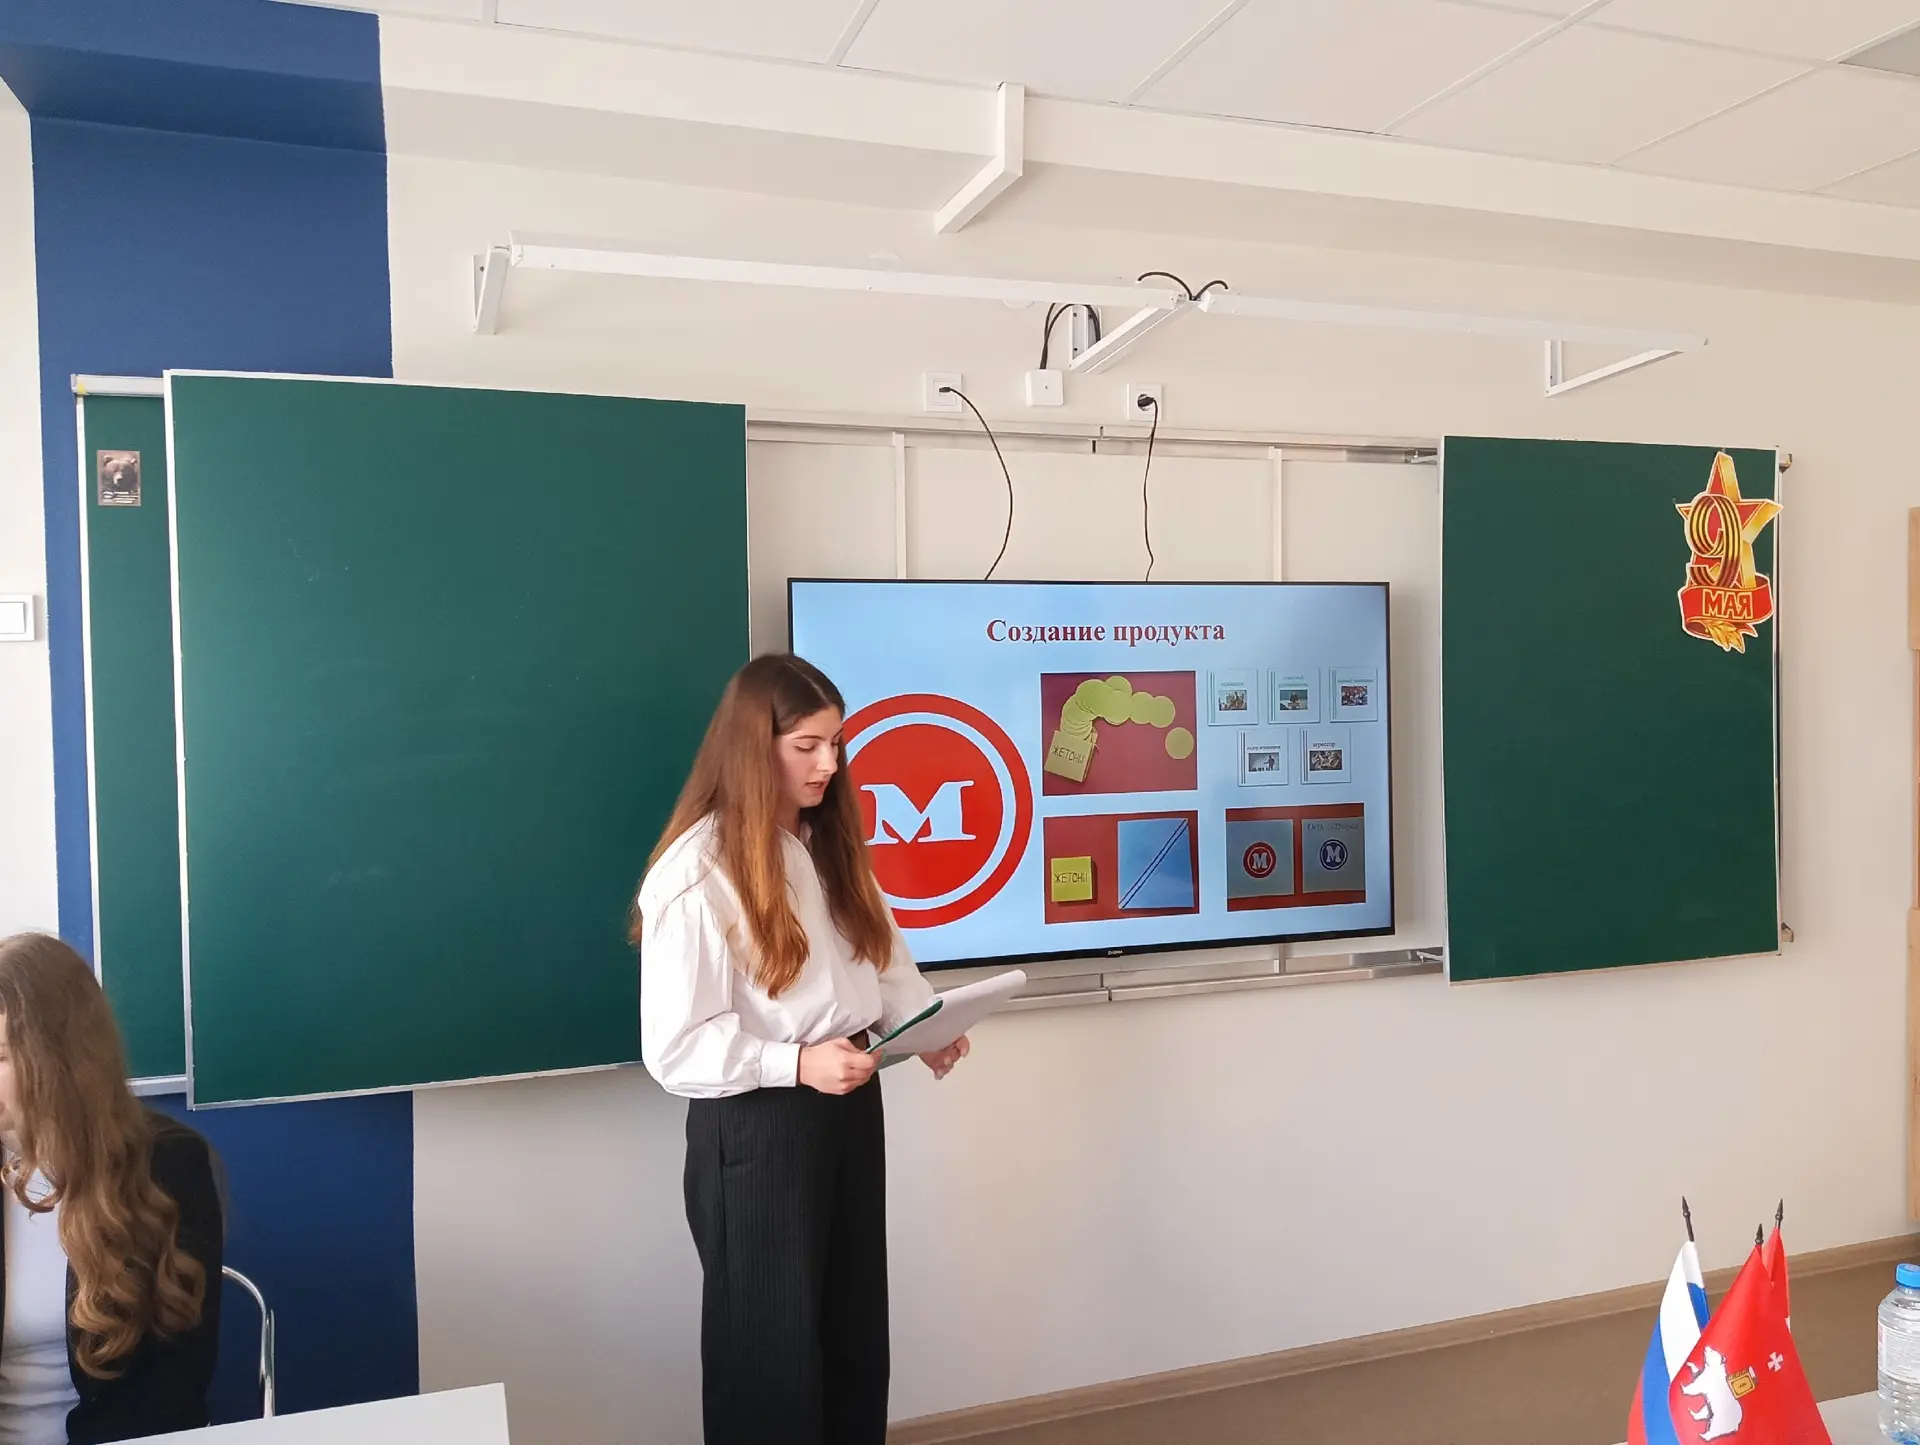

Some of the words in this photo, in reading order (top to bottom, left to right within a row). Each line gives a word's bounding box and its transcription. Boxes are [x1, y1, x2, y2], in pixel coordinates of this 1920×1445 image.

[1688, 493, 1742, 588] 9
[1702, 589, 1754, 619] МАЯ
[986, 619, 1106, 644] Создание
[1113, 624, 1225, 647] продукта
[1052, 745, 1085, 764] ЖЕТОНЫ
[860, 780, 977, 846] М
[1053, 872, 1088, 884] ЖЕТОНЫ
